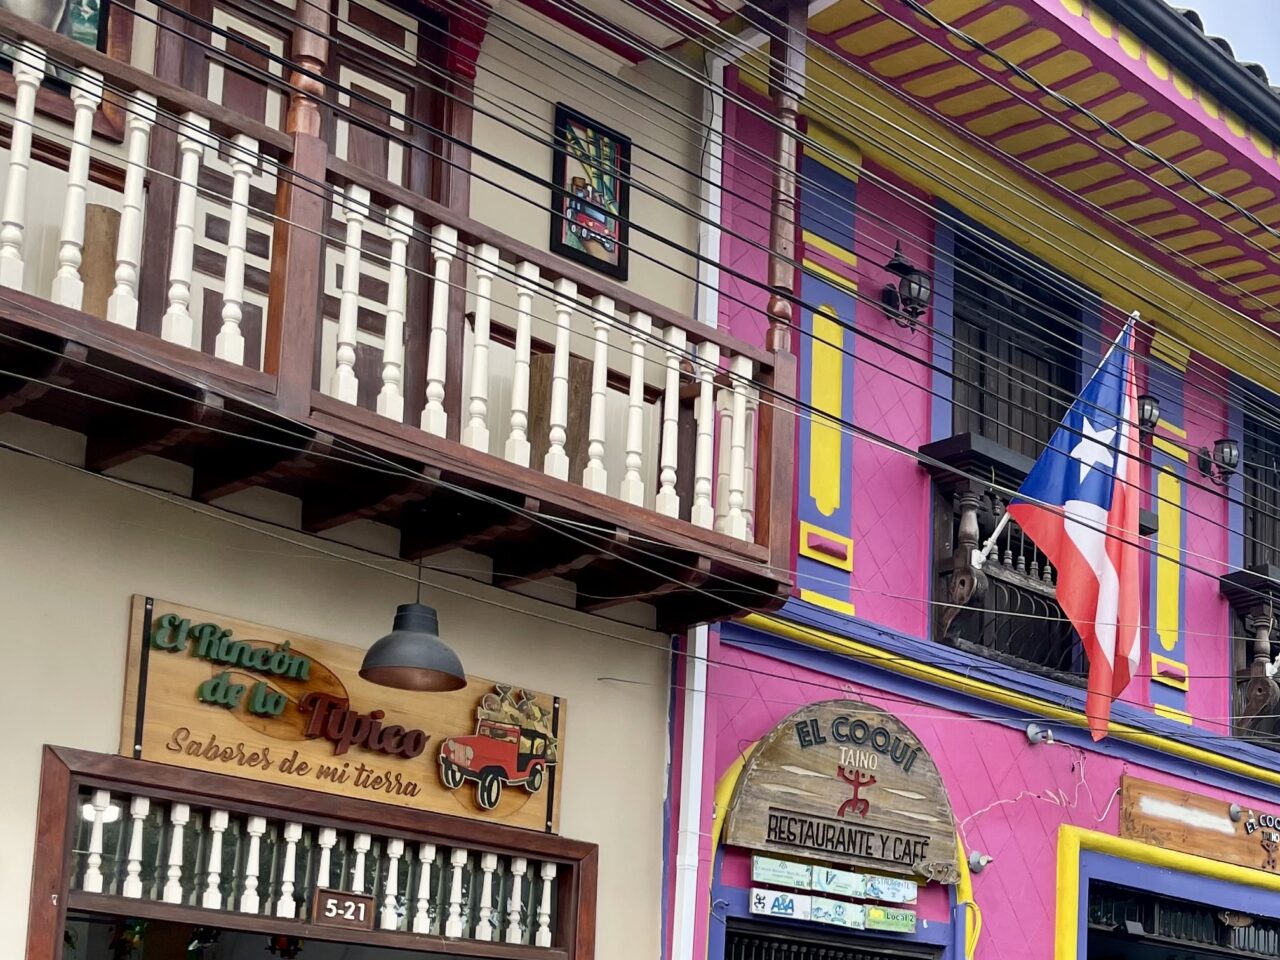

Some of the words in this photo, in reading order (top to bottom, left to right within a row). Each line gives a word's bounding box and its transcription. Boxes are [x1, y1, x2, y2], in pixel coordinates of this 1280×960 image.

[152, 613, 191, 652] El
[188, 622, 309, 681] Rincón
[197, 671, 246, 708] de
[249, 680, 288, 717] lo
[795, 718, 826, 749] EL
[166, 727, 275, 771] Sabores
[279, 750, 312, 776] de
[316, 756, 350, 784] mi
[354, 763, 421, 797] tierra
[767, 814, 874, 856] RESTAURANTE
[880, 833, 889, 858] Y
[325, 898, 365, 921] 5-21
[886, 911, 908, 921] Local
[909, 914, 914, 922] 2
